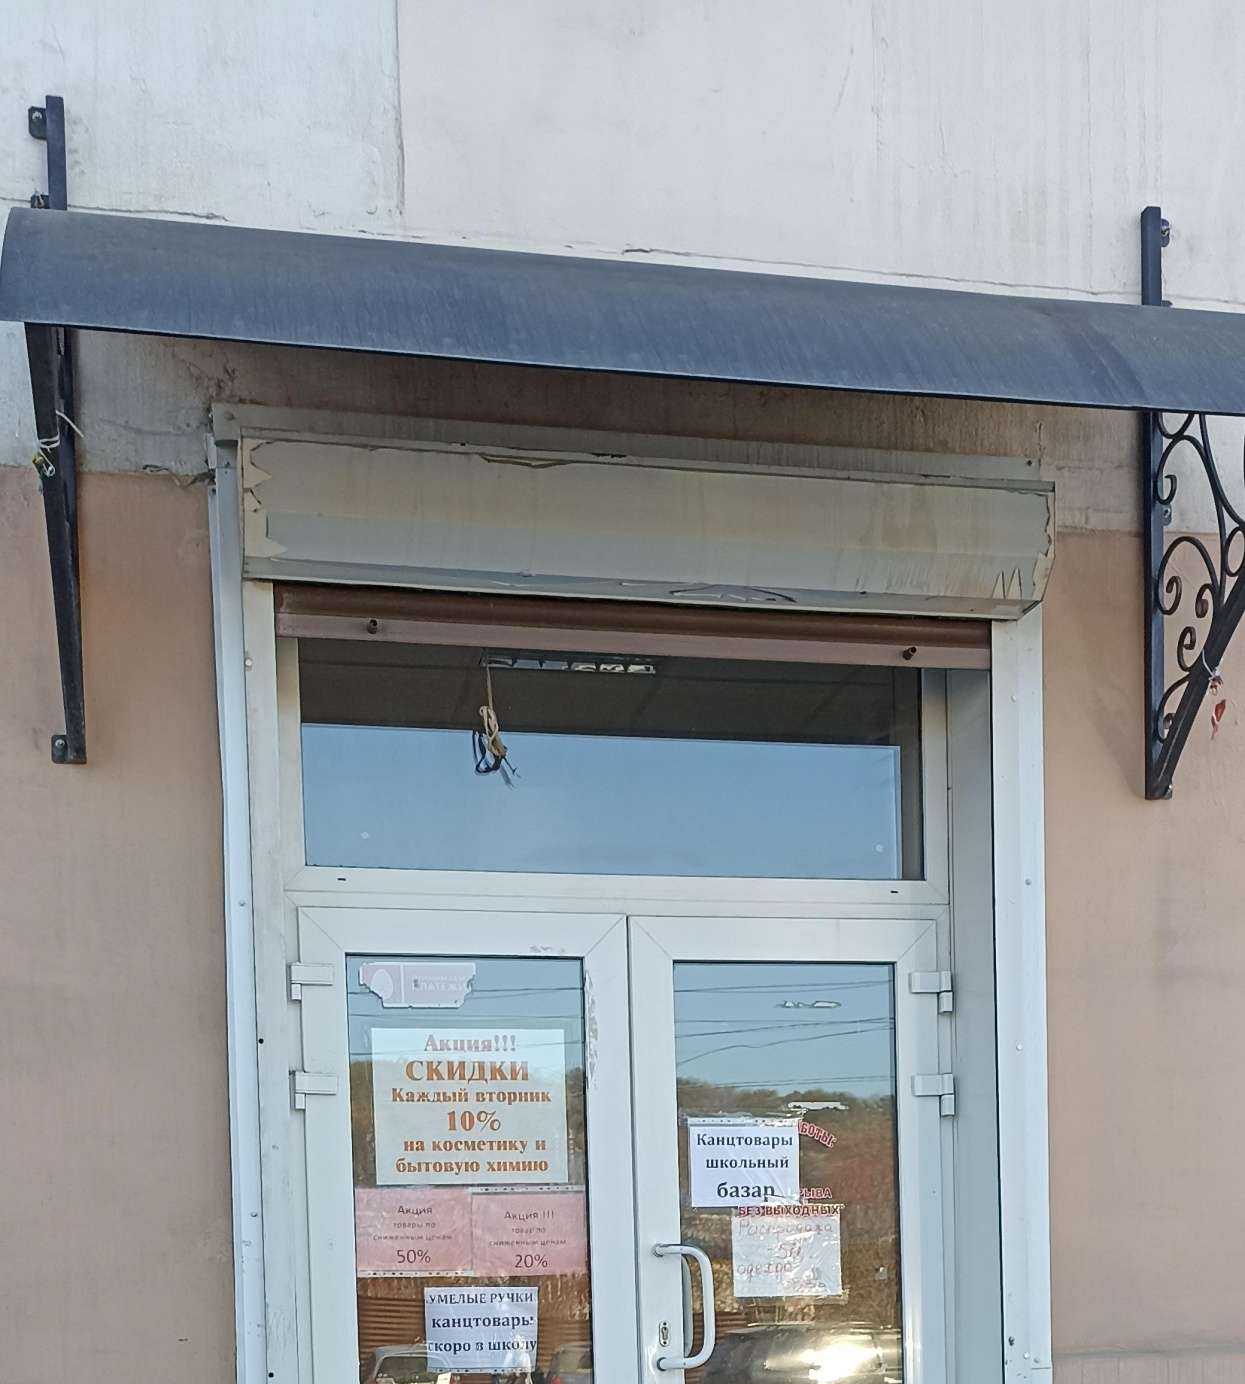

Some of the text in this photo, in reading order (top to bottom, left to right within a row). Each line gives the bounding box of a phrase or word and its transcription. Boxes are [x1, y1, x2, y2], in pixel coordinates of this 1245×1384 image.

[424, 1034, 517, 1053] Акция!!!
[405, 1060, 529, 1084] СКИДКИ
[391, 1087, 552, 1106] Каждый вторник
[447, 1109, 501, 1132] 10%
[696, 1133, 793, 1149] Канцтовары
[798, 1120, 837, 1148] БОТЫ:
[403, 1138, 546, 1154] на косметику и
[395, 1158, 549, 1175] бытовую химию
[705, 1154, 789, 1169] школьный
[716, 1182, 775, 1202] базар
[397, 1205, 433, 1216] Акция
[504, 1210, 539, 1222] Акция
[738, 1205, 839, 1216] БЕЗ ВЫХОДНЫХ
[396, 1249, 431, 1264] 50%
[514, 1254, 548, 1269] 20%
[475, 1341, 484, 1351] в
[488, 1340, 537, 1353] школу
